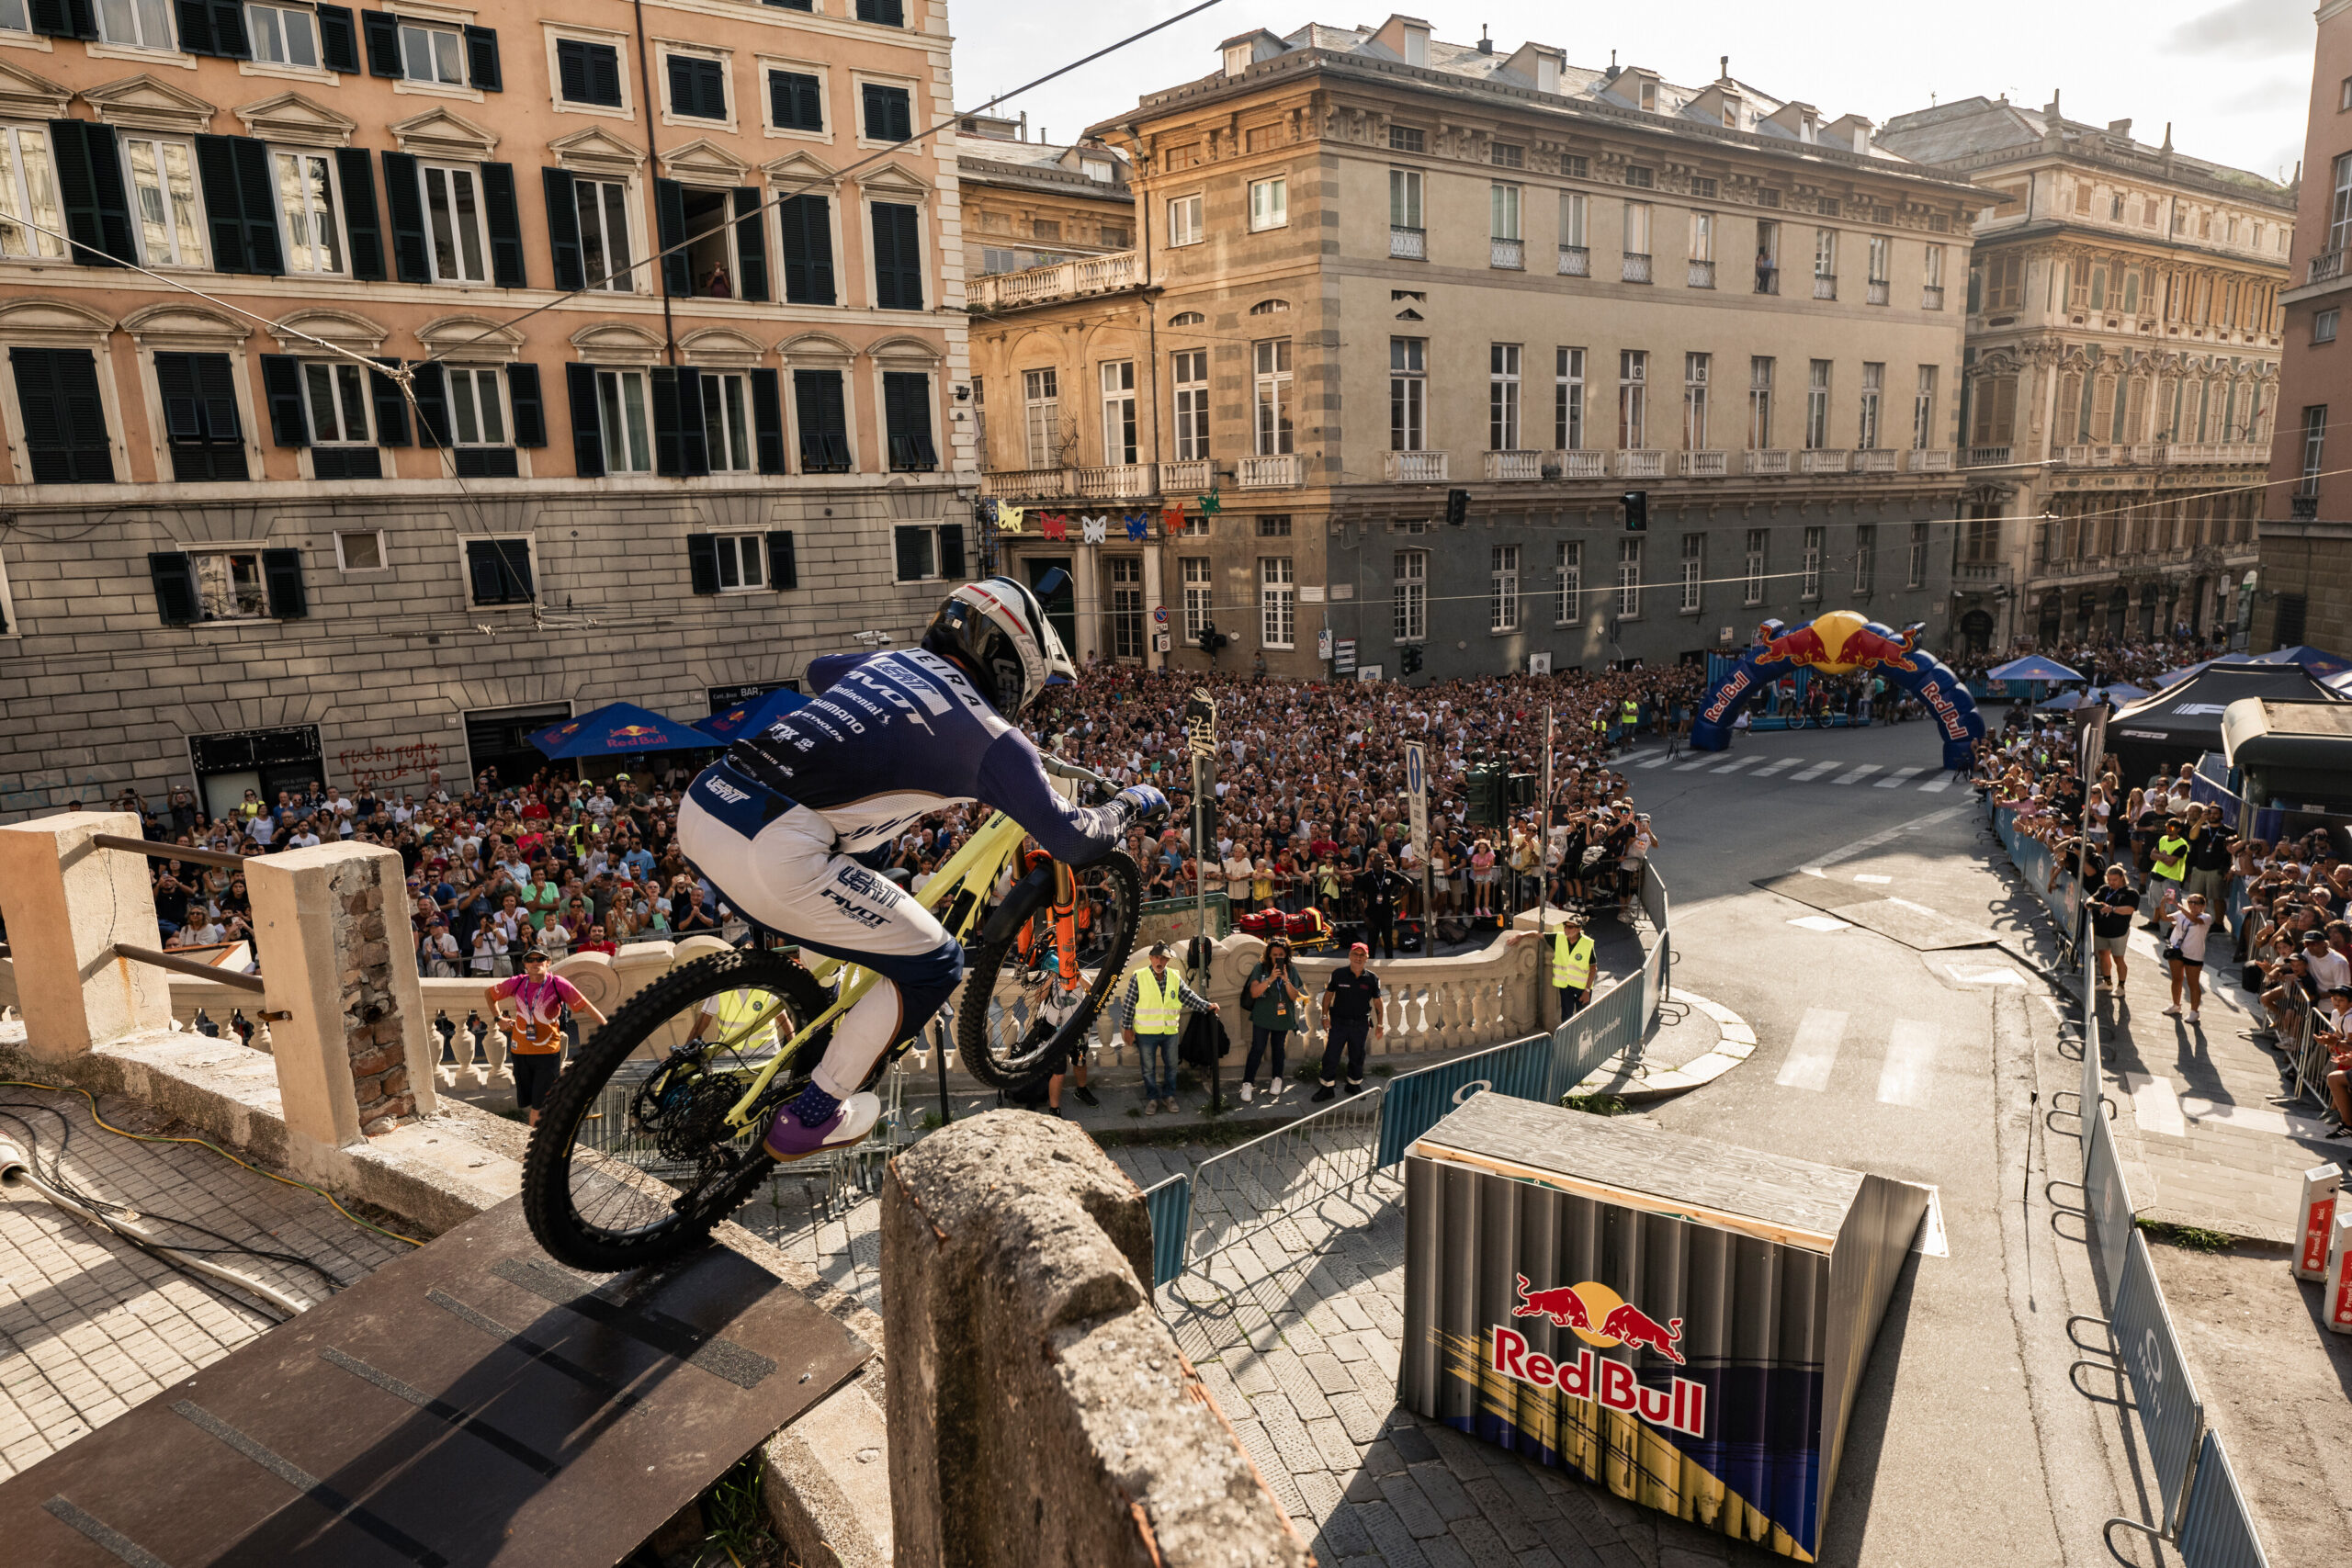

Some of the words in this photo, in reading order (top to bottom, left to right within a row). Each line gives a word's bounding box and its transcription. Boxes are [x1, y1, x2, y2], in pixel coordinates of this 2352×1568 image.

[874, 660, 938, 695] LEATT
[1015, 635, 1047, 684] LEATT
[741, 687, 759, 697] BAR
[1704, 692, 1730, 723] Red
[1722, 671, 1750, 699] Bull
[801, 712, 845, 743] REYNOLDS
[808, 698, 865, 735] SHIMANO
[1920, 681, 1954, 713] Red
[1940, 708, 1969, 740] Bull
[606, 738, 639, 748] Red
[639, 734, 669, 745] Bull
[768, 723, 800, 740] FOX
[706, 774, 752, 804] LEATT
[838, 865, 907, 909] LEATT
[820, 888, 892, 925] PIVOT
[838, 908, 861, 921] FACTORY
[1094, 975, 1118, 1012] Continental
[2312, 1235, 2321, 1257] Prendi
[1493, 1325, 1594, 1402] Red
[1599, 1357, 1705, 1438] Bull
